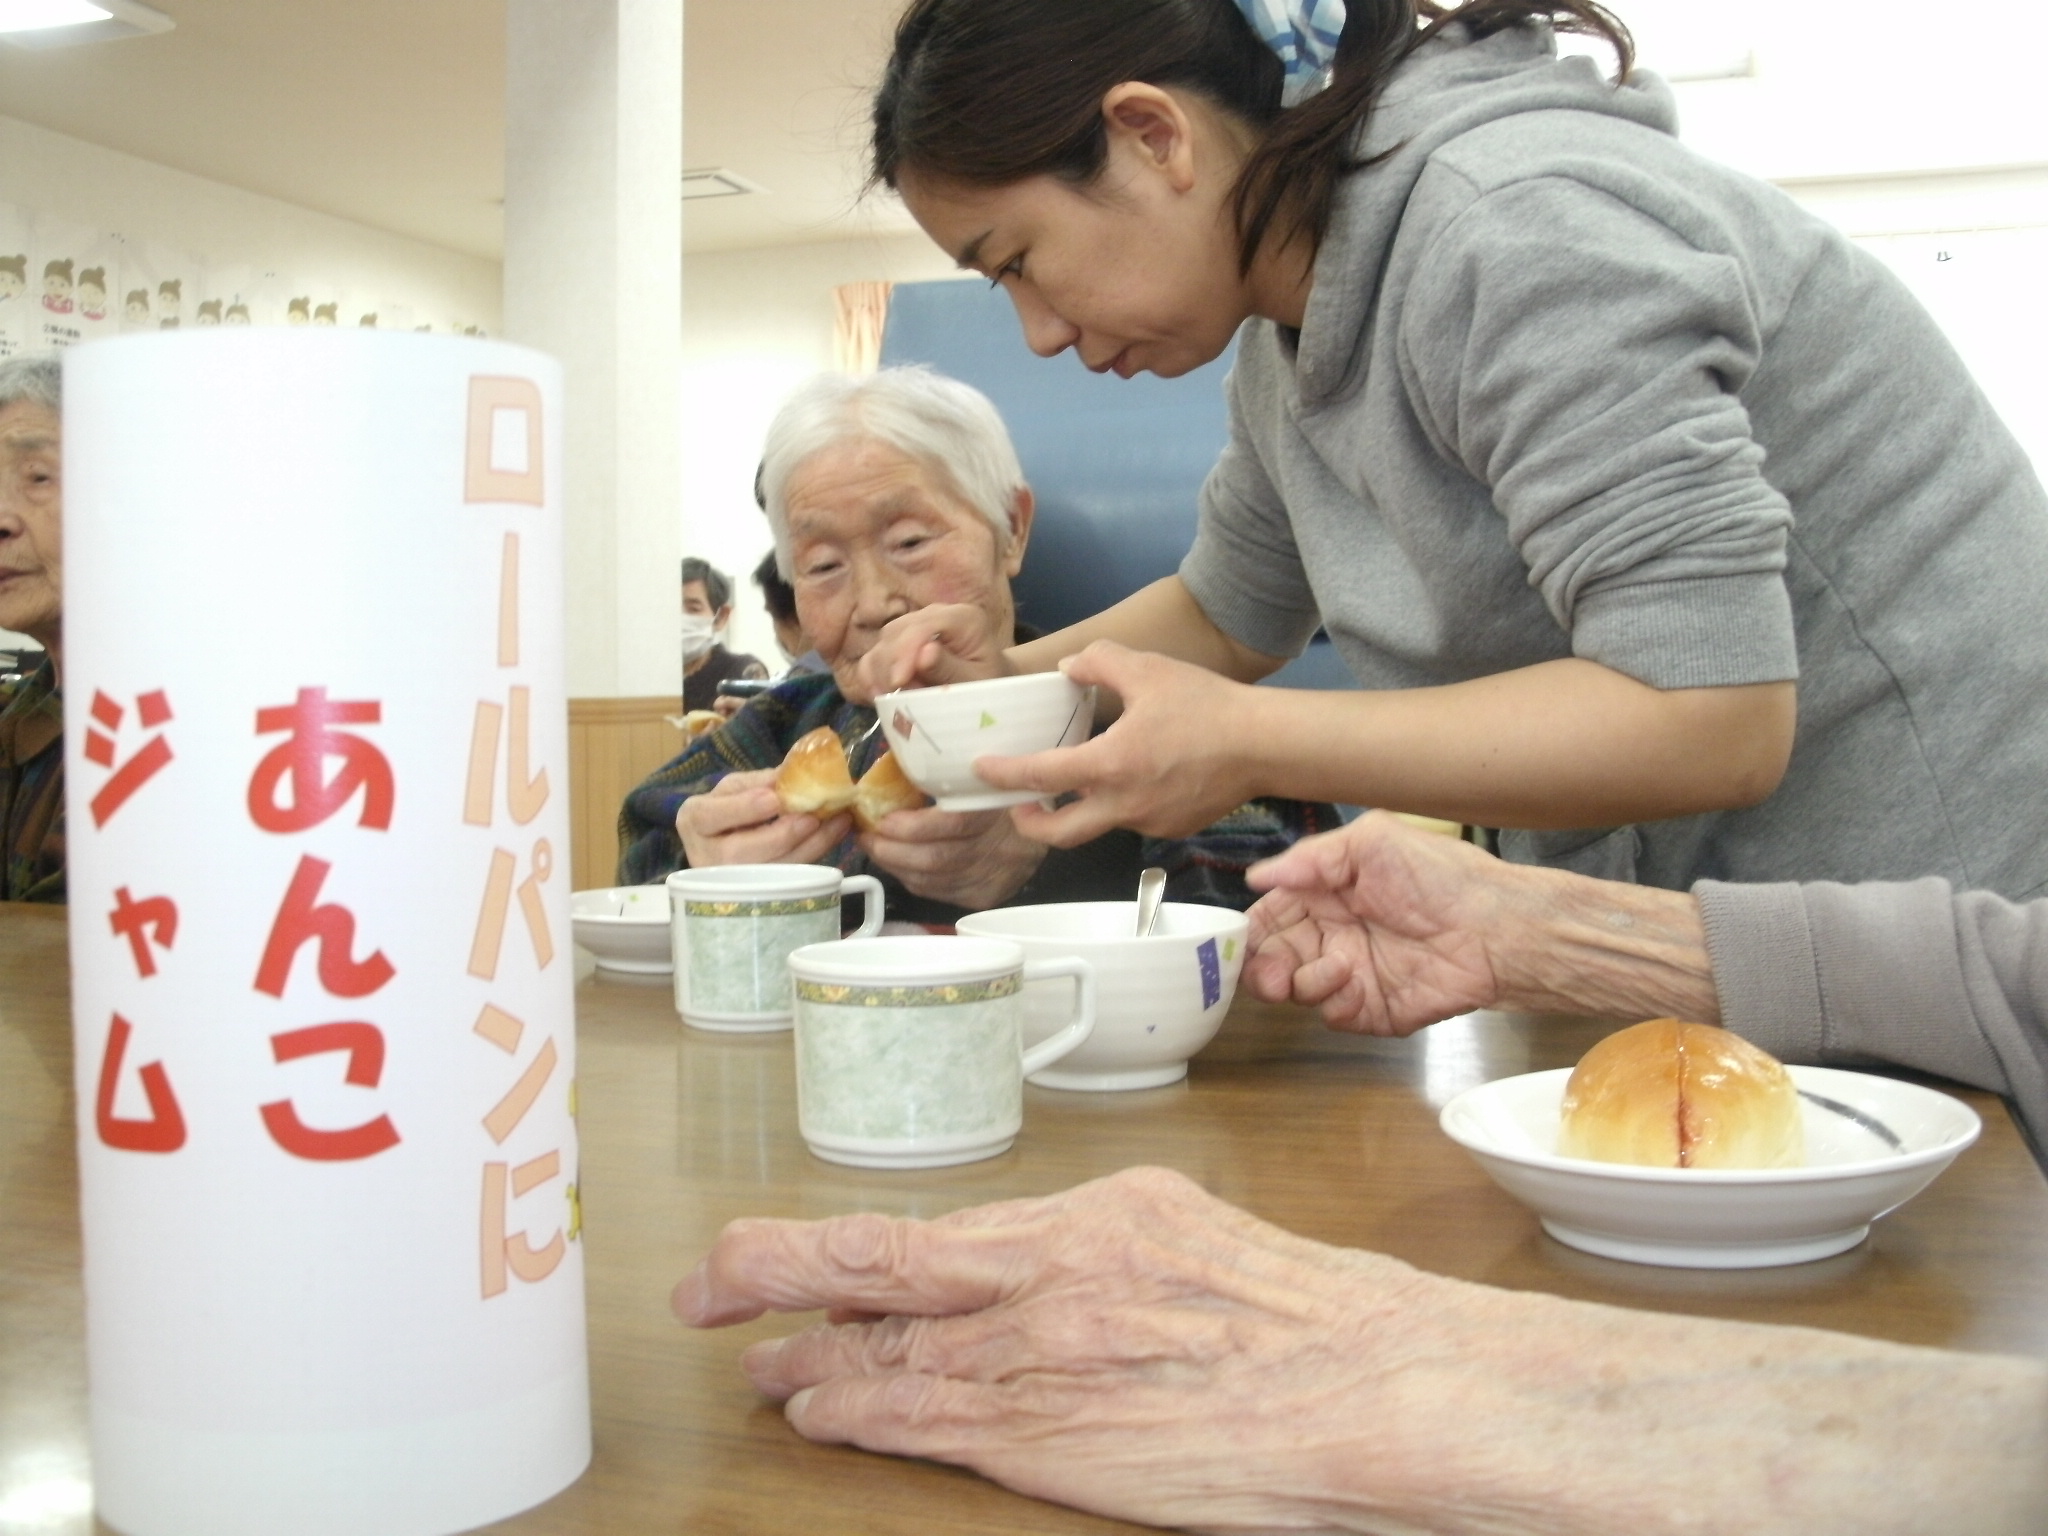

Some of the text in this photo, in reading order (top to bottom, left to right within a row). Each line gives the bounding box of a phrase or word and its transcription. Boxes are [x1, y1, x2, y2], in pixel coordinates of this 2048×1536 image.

[84, 688, 188, 1154] ジャム
[247, 686, 402, 1162] あんこ
[463, 374, 567, 1300] ロールパンに
